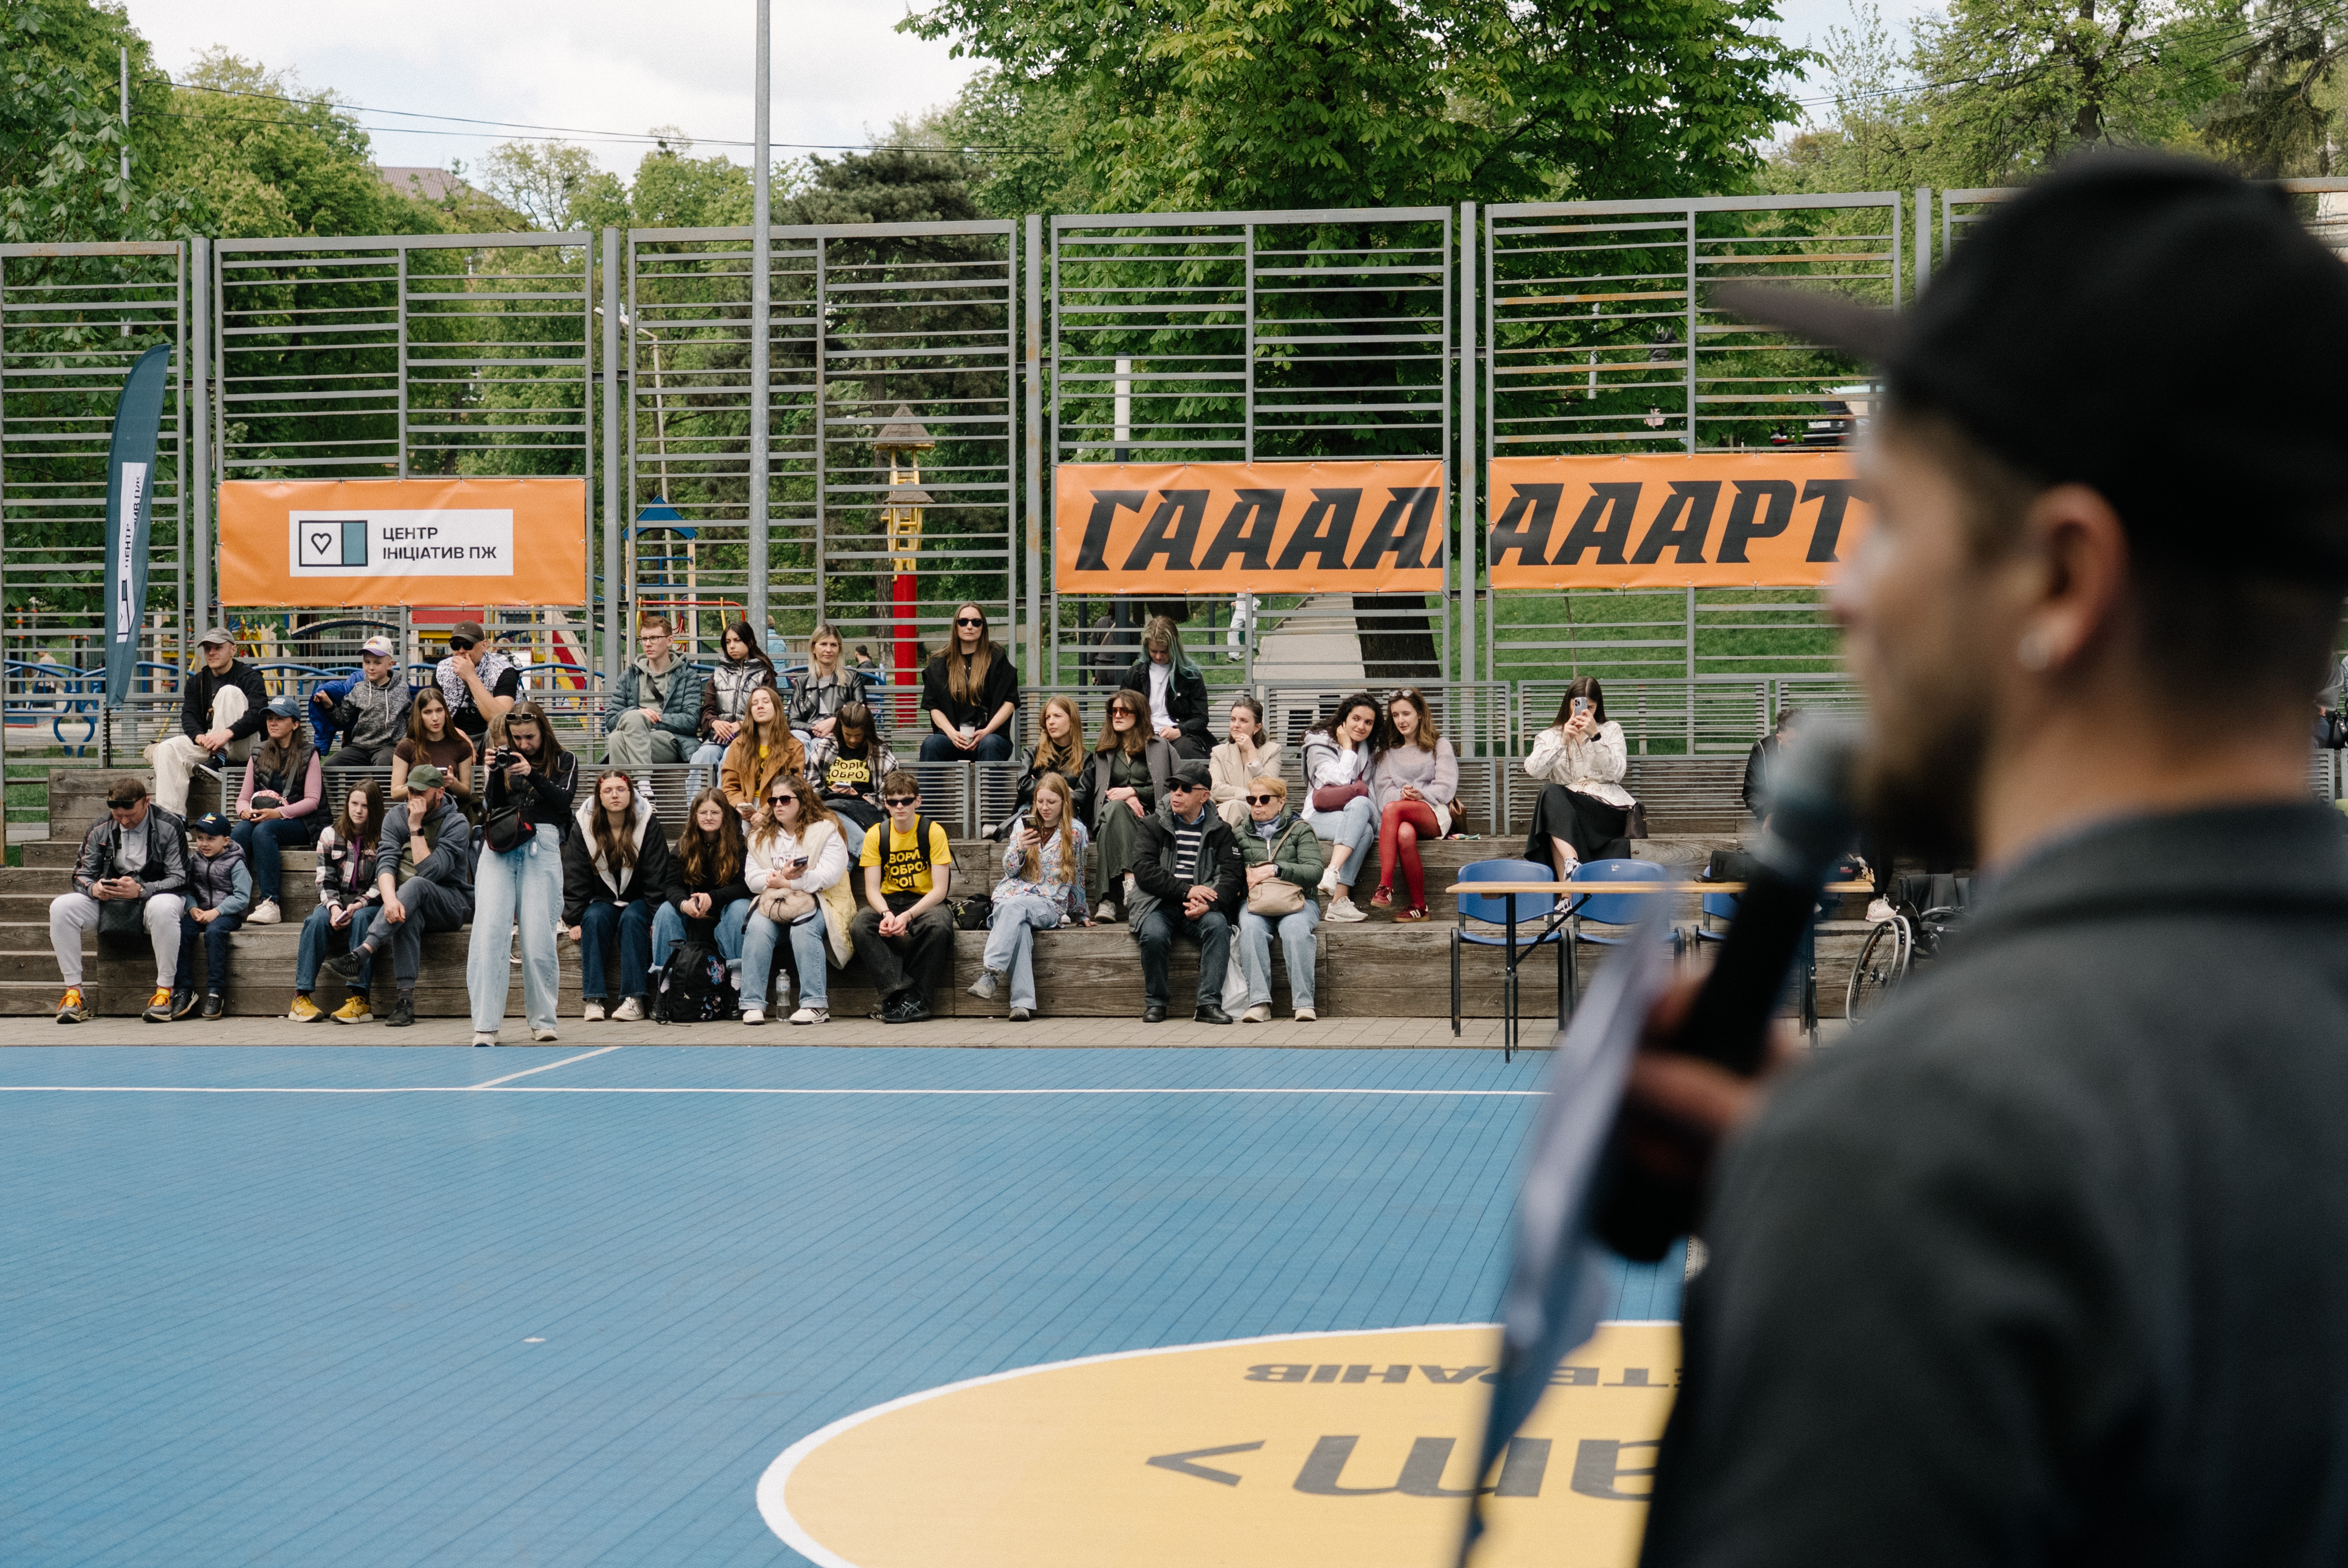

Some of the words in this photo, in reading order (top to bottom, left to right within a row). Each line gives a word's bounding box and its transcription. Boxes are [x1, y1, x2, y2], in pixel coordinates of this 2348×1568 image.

[383, 527, 438, 541] ЦЕНТР
[1074, 487, 1443, 570] ГАААА
[383, 546, 465, 561] ІНІЦІАТИВ
[469, 546, 497, 559] ПЖ
[833, 759, 864, 770] ВОРИ
[889, 849, 921, 864] ВОРИ
[887, 862, 925, 876] ОБРО,
[890, 876, 913, 888] РО!
